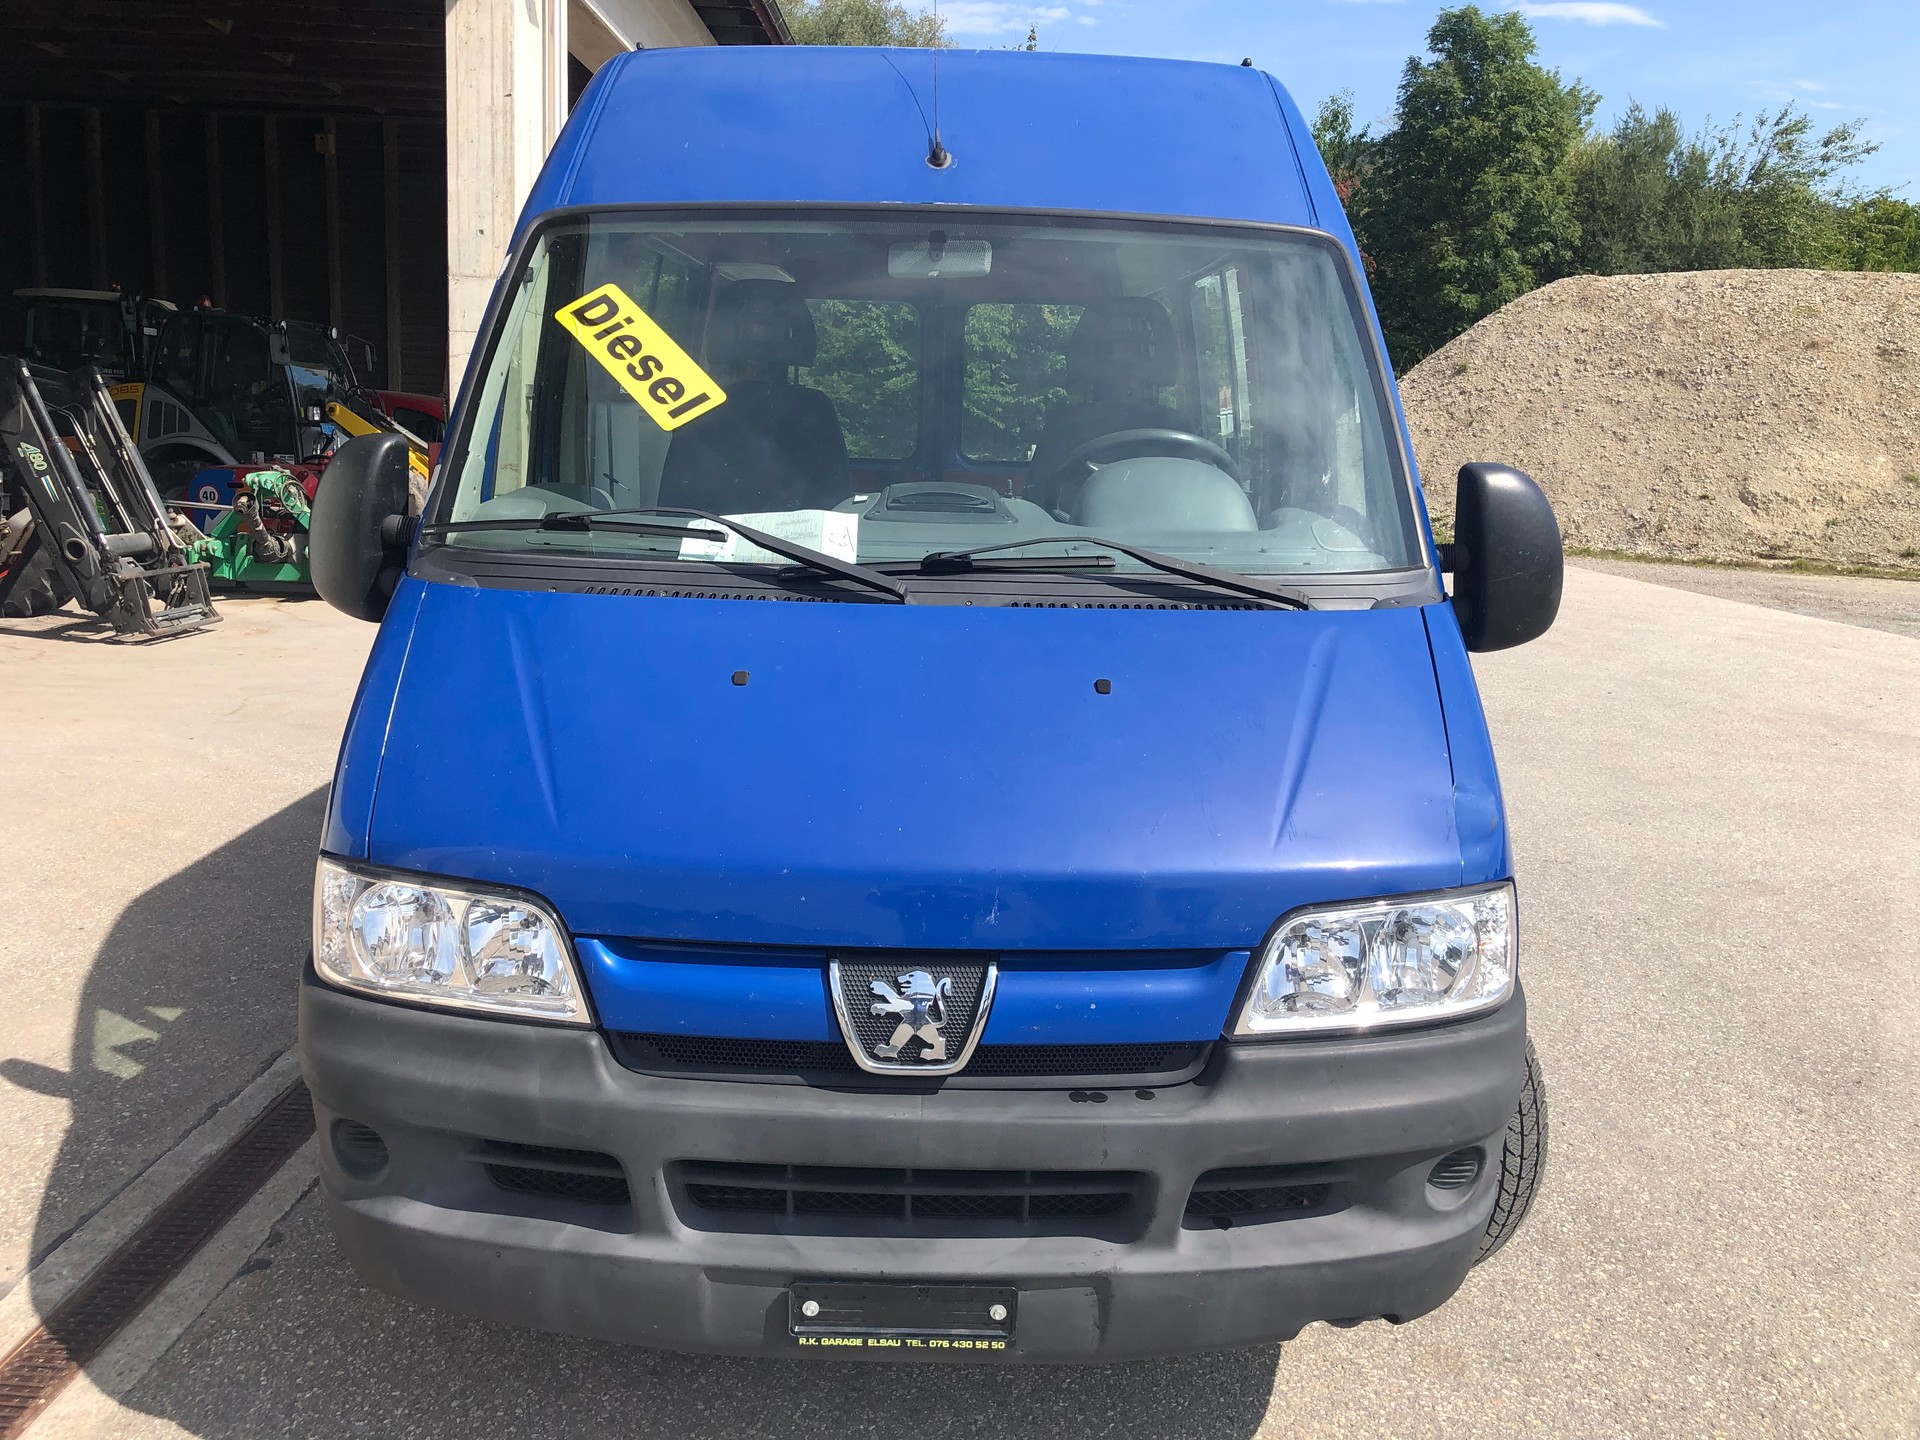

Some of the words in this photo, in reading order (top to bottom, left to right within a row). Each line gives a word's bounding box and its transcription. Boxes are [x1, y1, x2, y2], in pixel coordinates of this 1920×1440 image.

[570, 294, 711, 420] Diesel
[17, 442, 48, 471] 480
[202, 491, 216, 501] 40
[799, 1338, 819, 1346] R.K.
[821, 1338, 863, 1346] GARAGE
[868, 1339, 901, 1347] ELSAU
[906, 1339, 927, 1347] TEL.
[929, 1340, 950, 1348] 076
[952, 1340, 973, 1349] 430
[975, 1341, 989, 1349] 52
[991, 1341, 1005, 1349] 50
